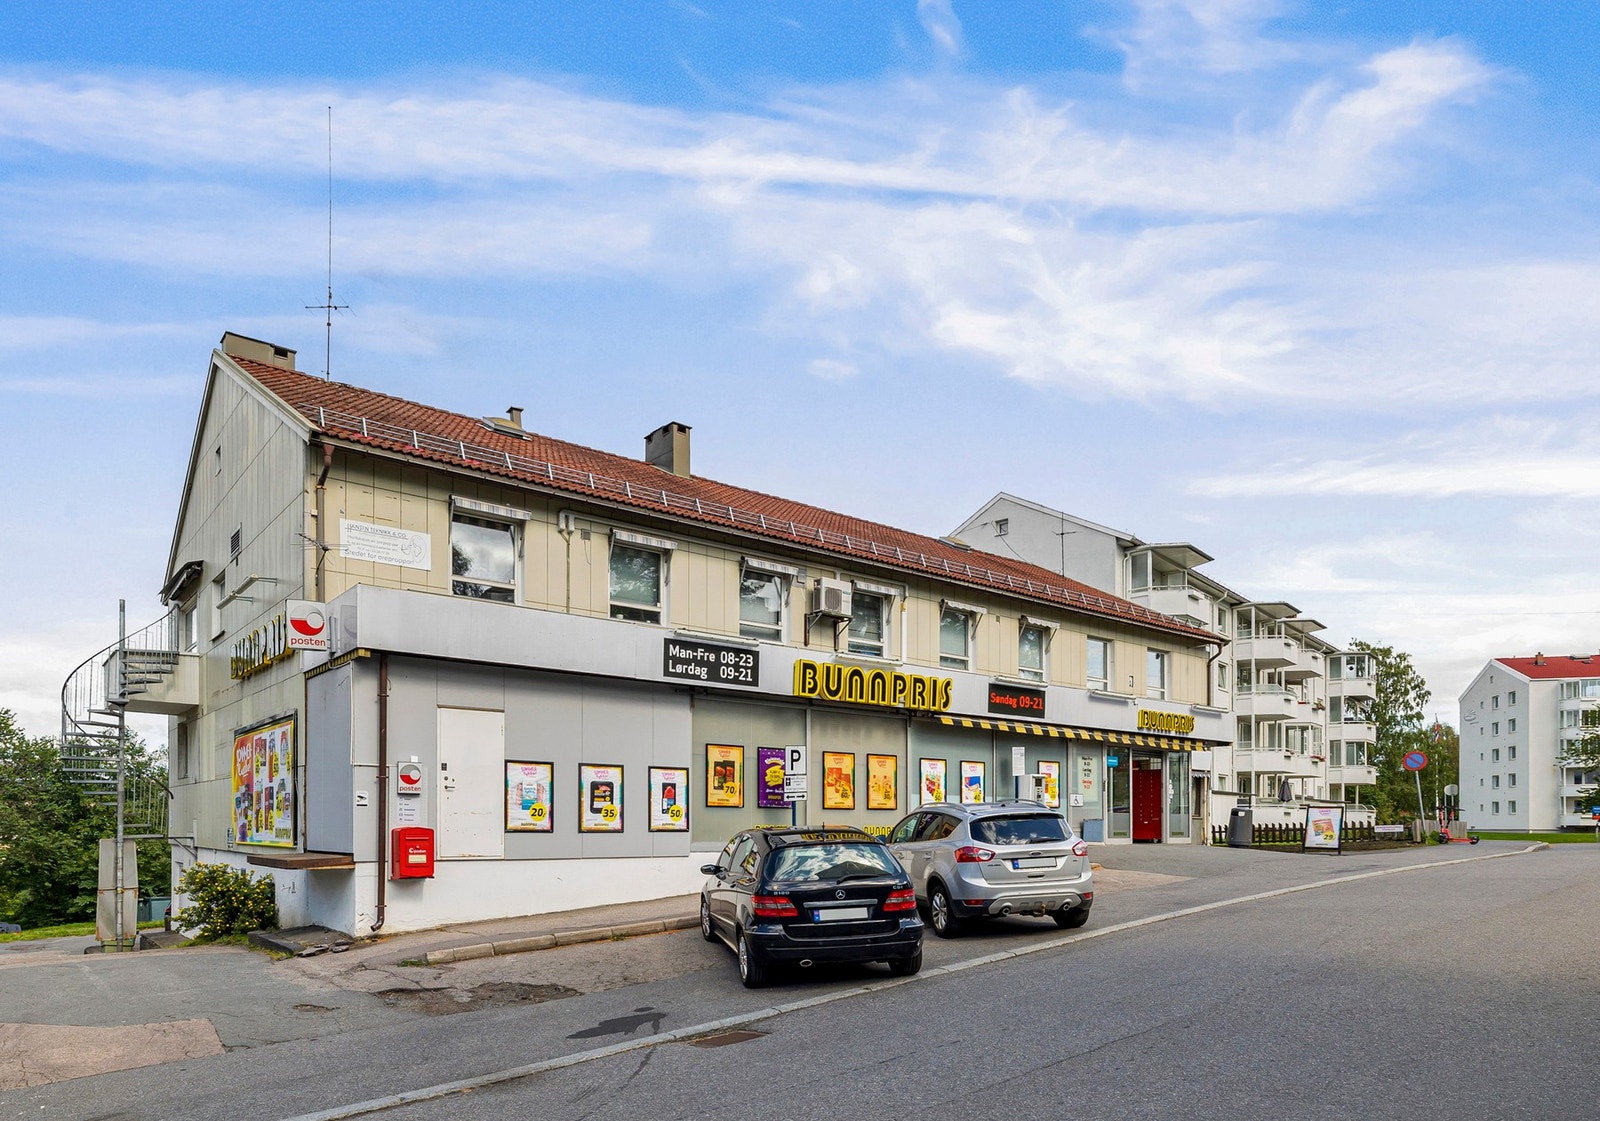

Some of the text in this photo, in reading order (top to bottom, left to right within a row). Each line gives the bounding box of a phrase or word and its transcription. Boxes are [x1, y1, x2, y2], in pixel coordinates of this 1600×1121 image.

[344, 548, 366, 557] Stedet
[367, 551, 377, 559] for
[290, 637, 326, 647] posten
[668, 643, 754, 667] Man-Fre 08-23
[668, 659, 753, 682] Lørdag 09-21
[793, 658, 953, 712] BUNNPRIS
[990, 691, 1043, 710] Søndag 09-21
[1138, 709, 1195, 734] BUNNPRIS
[790, 749, 802, 771] P
